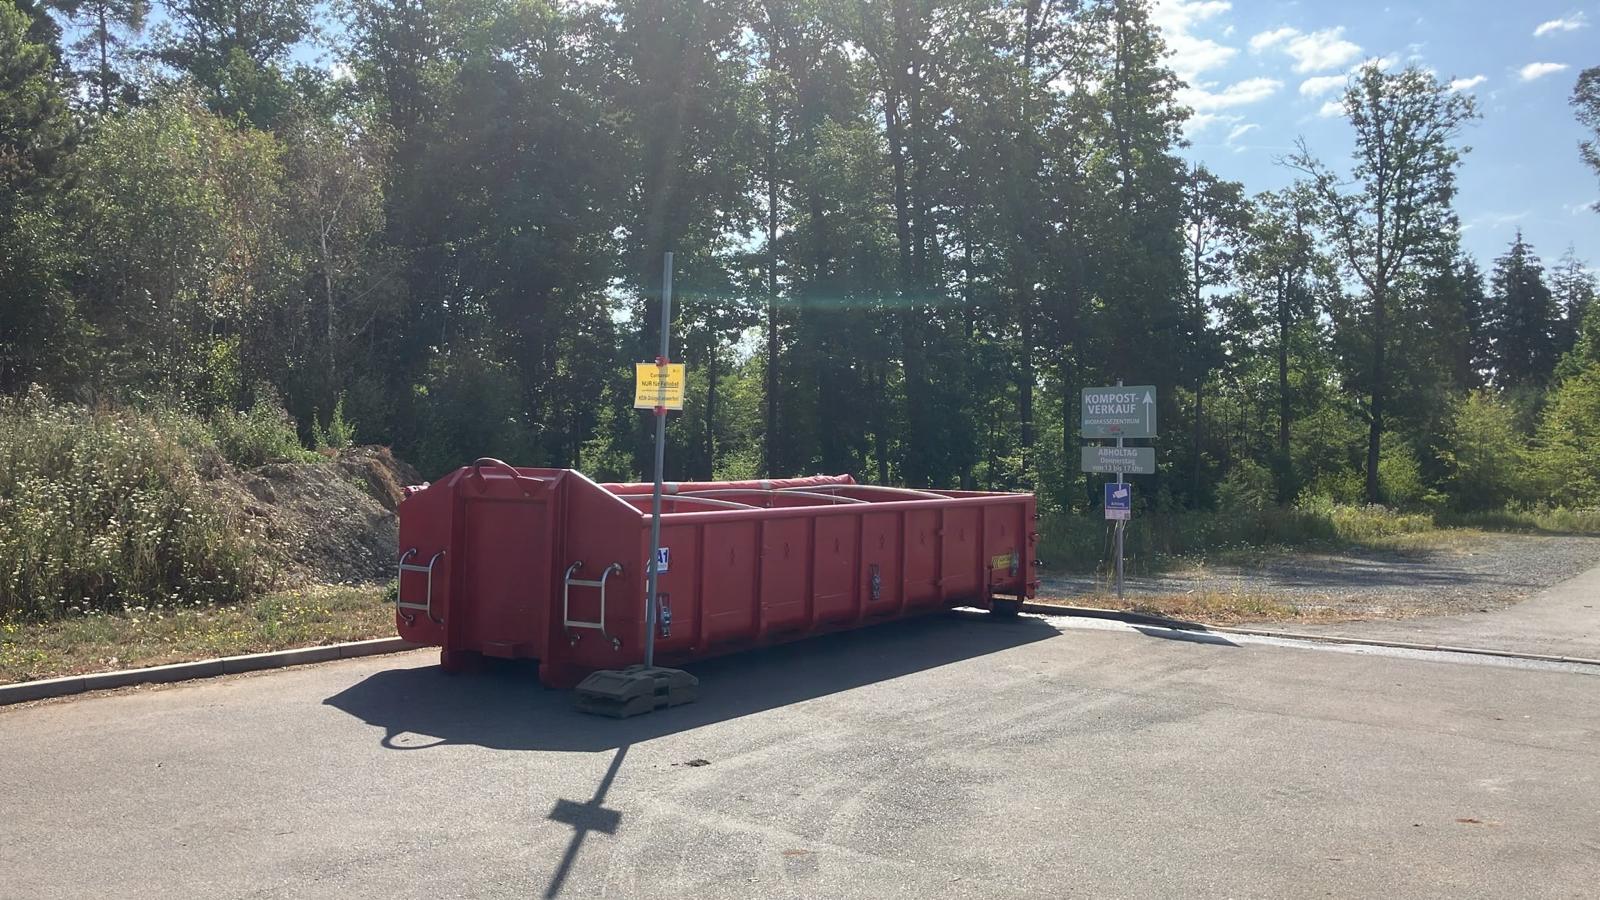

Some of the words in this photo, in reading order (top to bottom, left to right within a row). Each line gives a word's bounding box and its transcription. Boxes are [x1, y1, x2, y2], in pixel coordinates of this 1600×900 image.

[1085, 393, 1140, 404] KOMPOST-
[1088, 404, 1136, 414] VERKAUF
[1098, 448, 1138, 457] ABHOLTAG
[1100, 457, 1136, 466] Donnerstag
